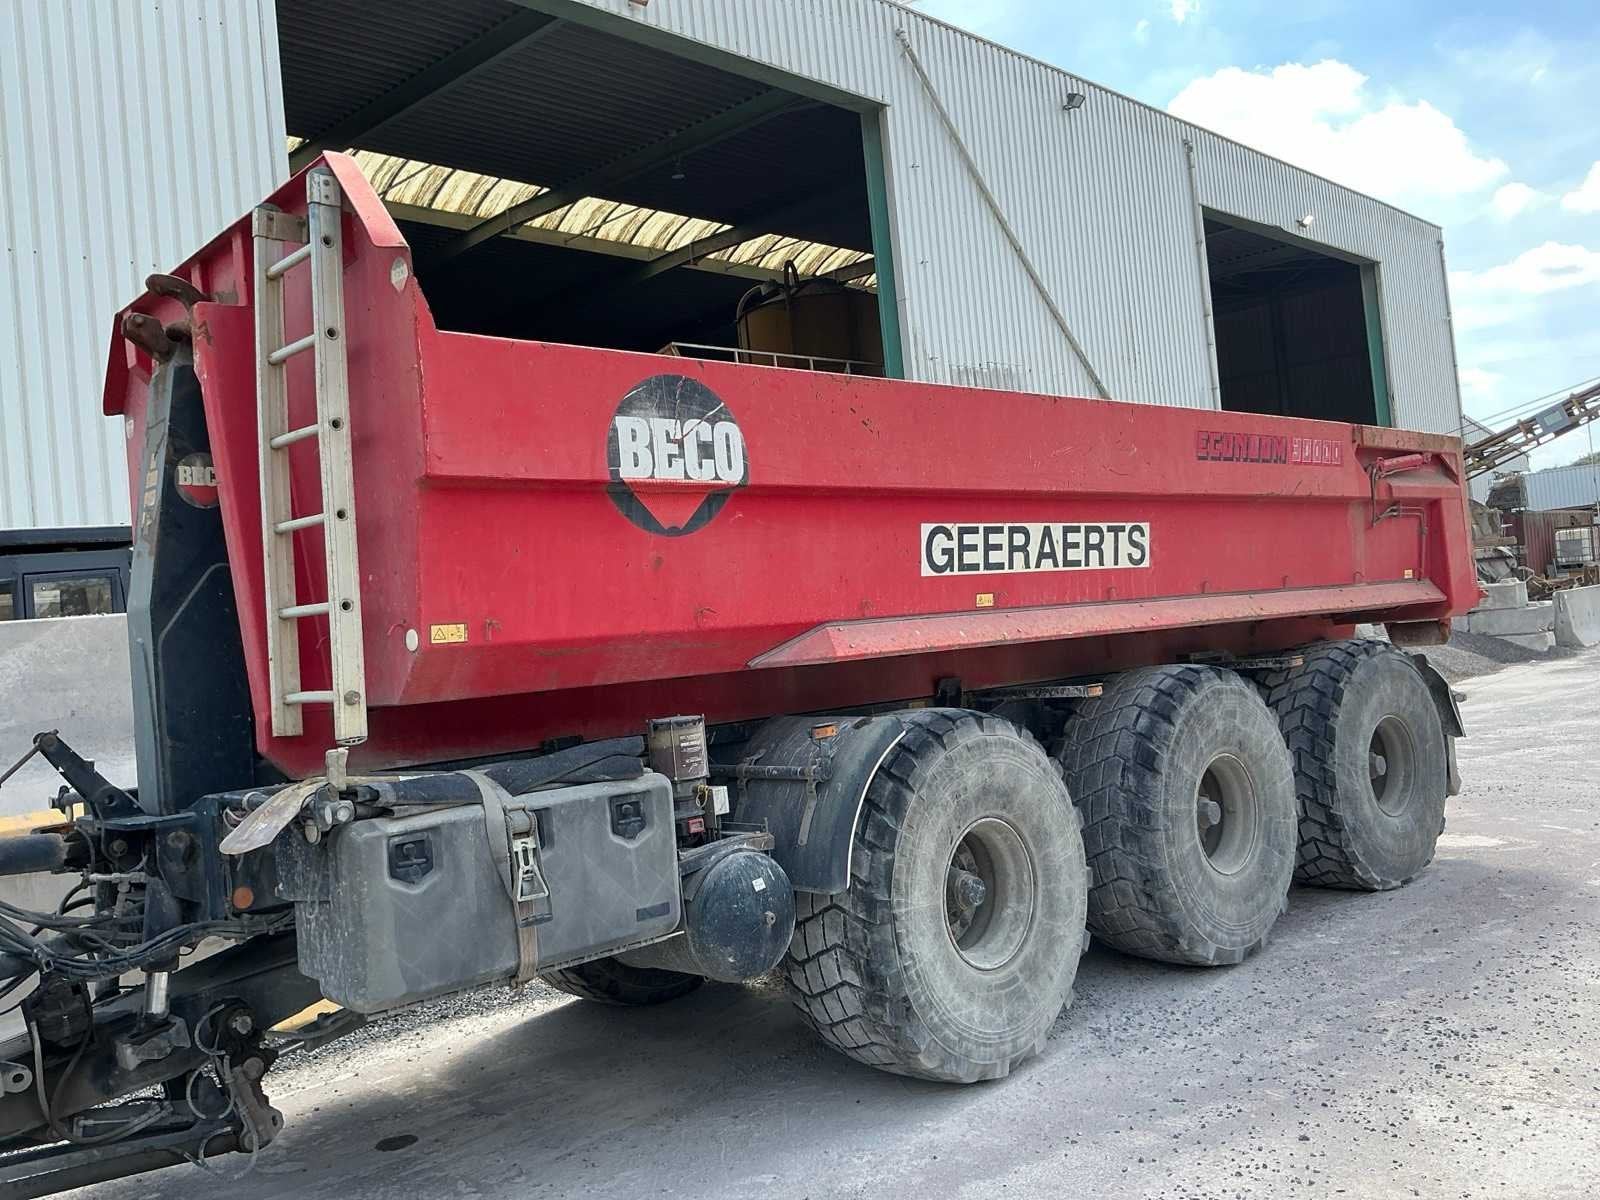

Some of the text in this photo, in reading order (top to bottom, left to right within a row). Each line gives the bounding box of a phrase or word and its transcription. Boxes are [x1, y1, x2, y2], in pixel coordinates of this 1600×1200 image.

[615, 416, 744, 481] BECO
[1291, 437, 1344, 466] 30000
[176, 465, 218, 487] BEC
[925, 524, 1147, 574] GEERAERTS
